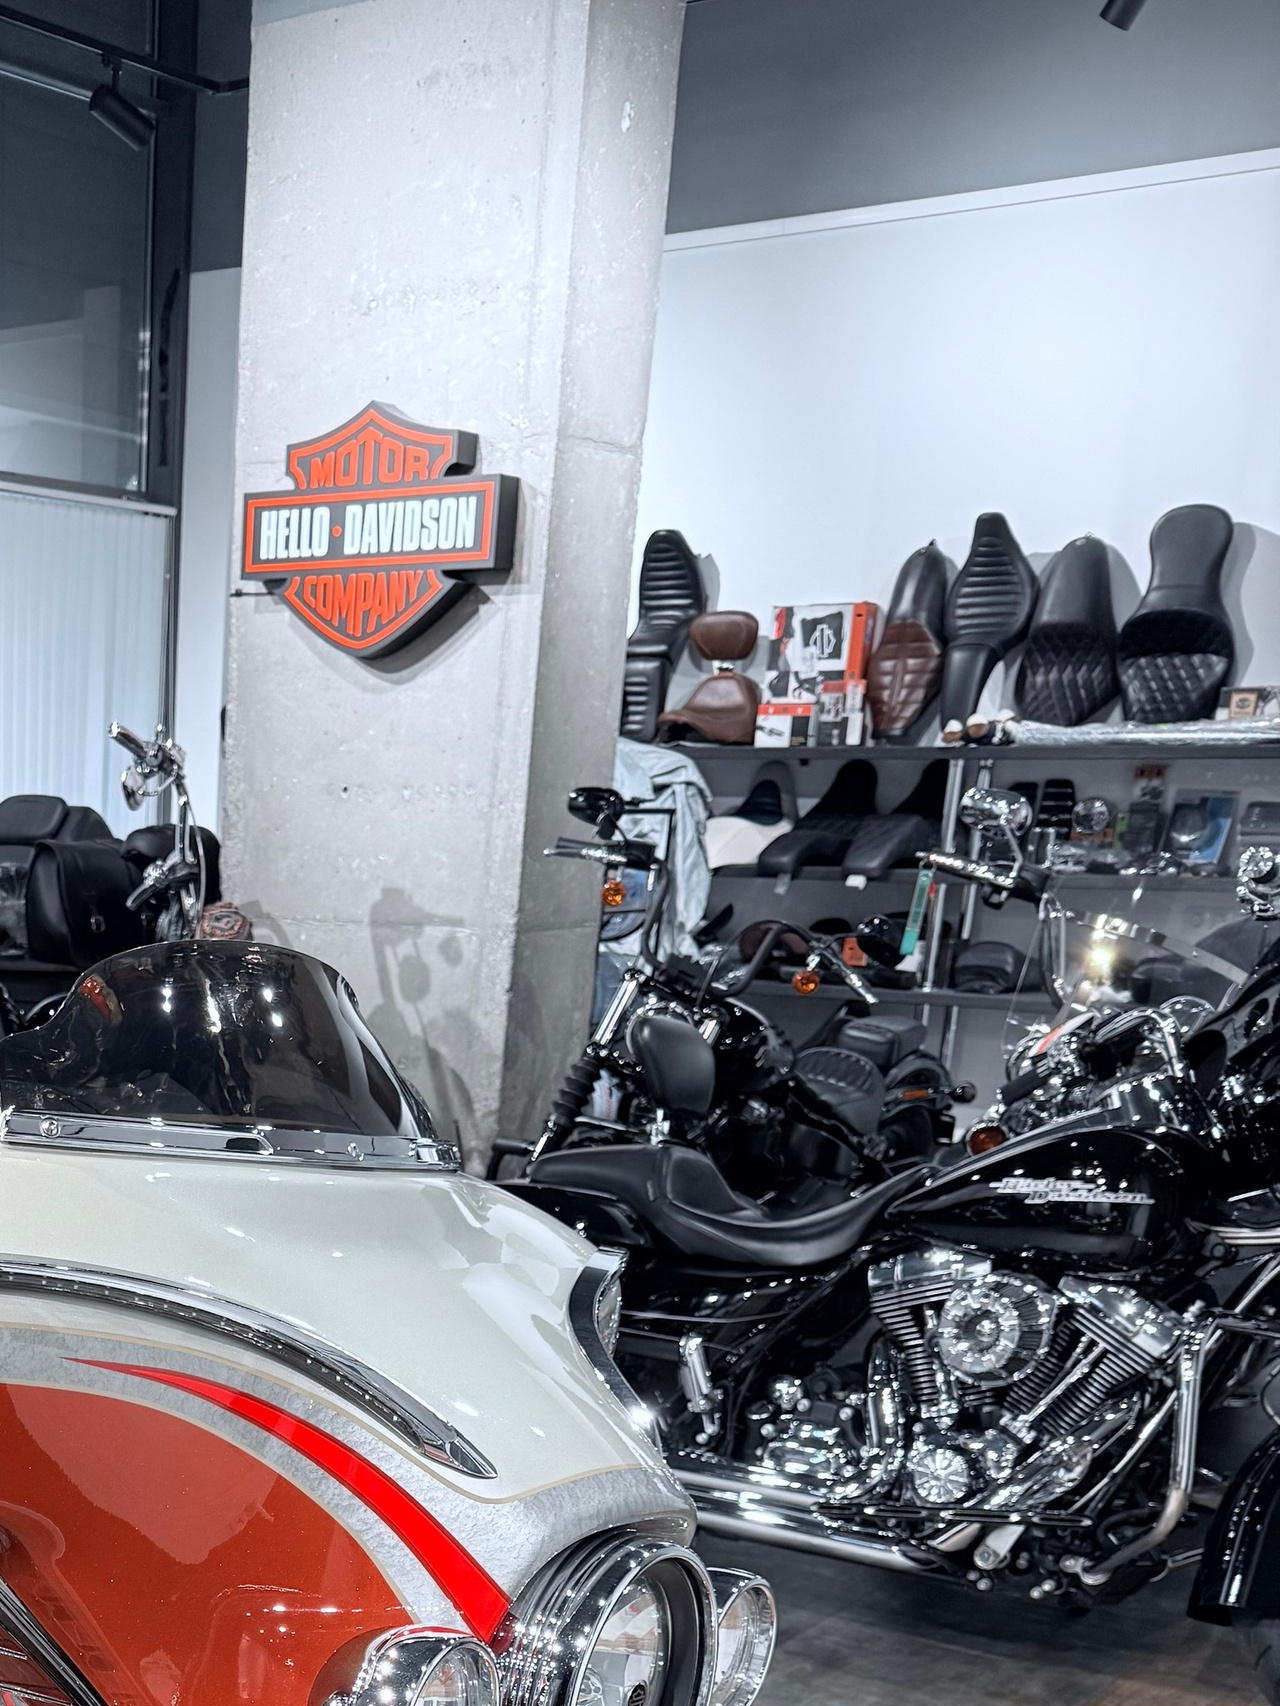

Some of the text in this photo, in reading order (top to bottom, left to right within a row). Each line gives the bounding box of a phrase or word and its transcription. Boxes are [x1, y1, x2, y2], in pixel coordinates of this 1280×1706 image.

[310, 427, 429, 489] MOTOR
[259, 495, 477, 560] HELLO DAVIDSON
[303, 570, 423, 637] COMPANY
